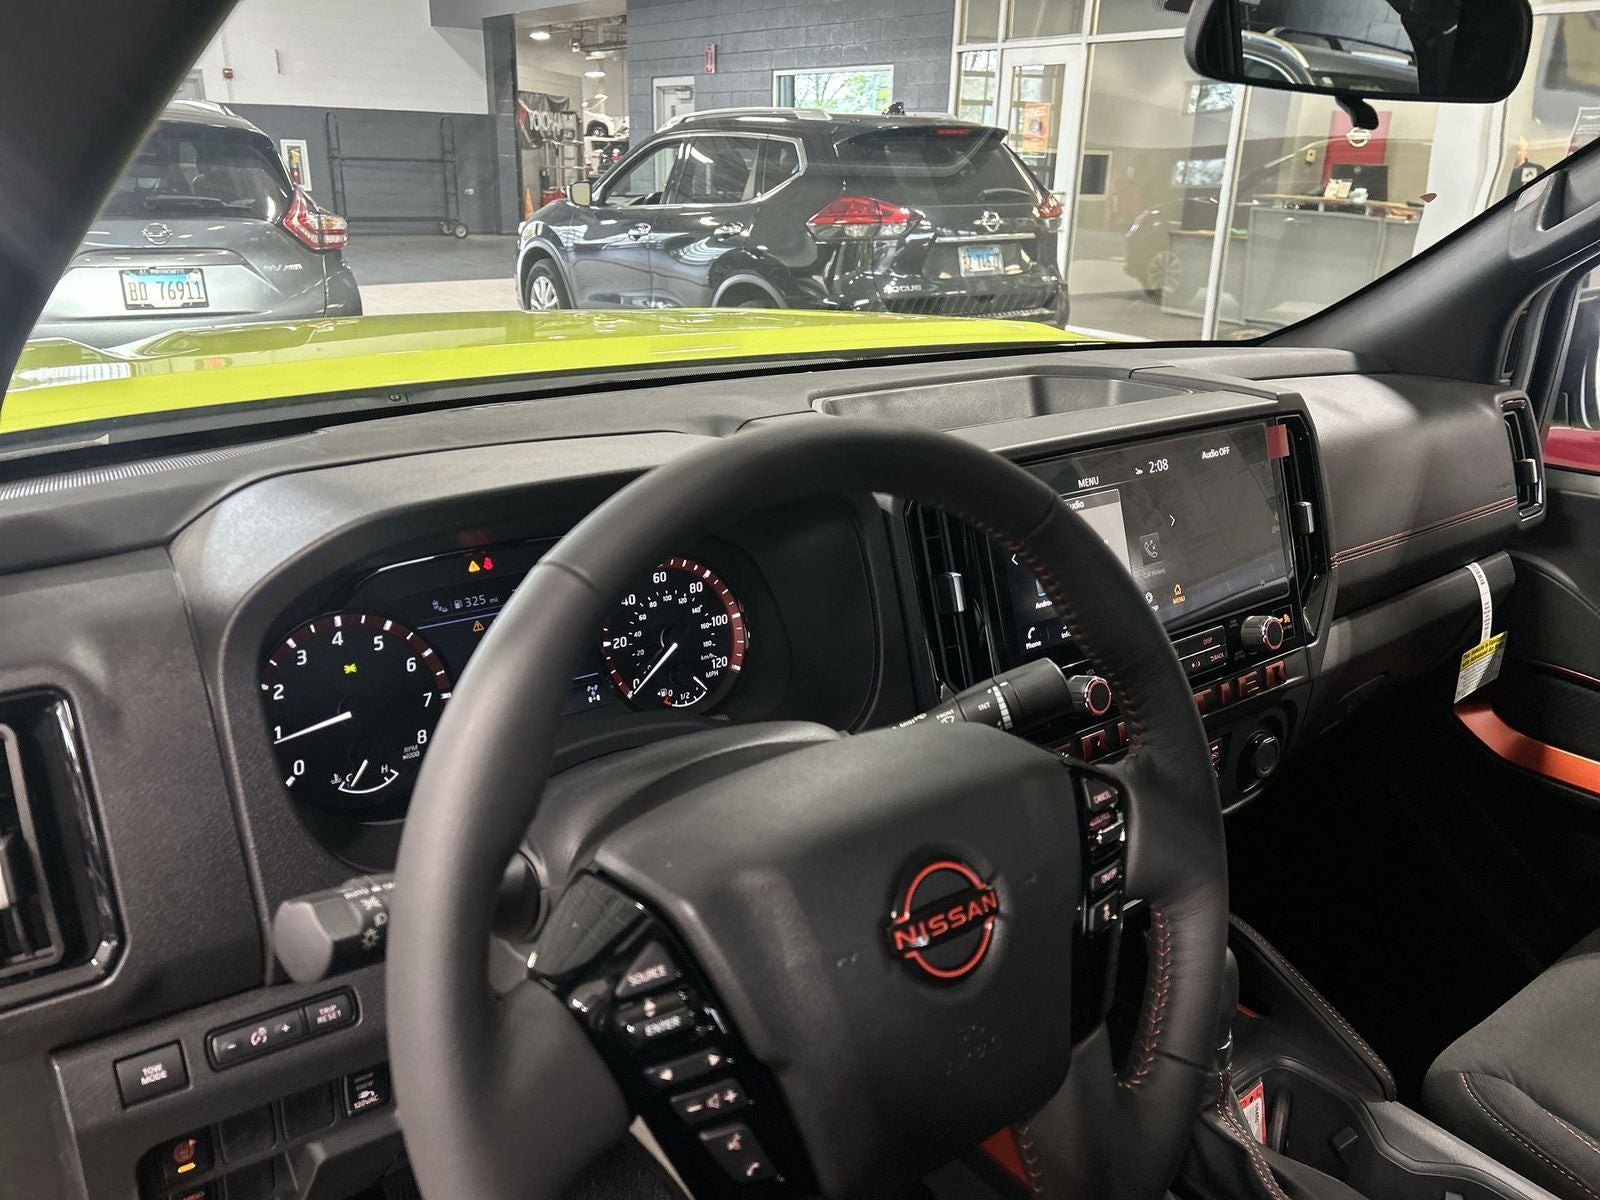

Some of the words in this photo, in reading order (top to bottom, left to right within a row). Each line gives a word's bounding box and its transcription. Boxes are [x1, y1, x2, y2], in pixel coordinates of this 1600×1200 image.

[128, 282, 148, 301] BD
[156, 280, 204, 300] 76911
[1202, 449, 1218, 459] Audio
[1219, 446, 1230, 456] OFF
[1148, 458, 1169, 473] 2:08
[1078, 476, 1099, 489] MENU
[652, 571, 667, 583] 60
[689, 581, 703, 593] 80
[465, 595, 487, 608] 325
[621, 594, 636, 606] 40
[662, 594, 673, 602] 100
[711, 614, 728, 627] 100
[331, 631, 343, 646] 4
[373, 635, 384, 651] 5
[613, 636, 627, 649] 20
[1025, 639, 1042, 650] Phone
[296, 650, 307, 665] 3
[712, 656, 728, 669] 120
[406, 657, 416, 672] 6
[705, 671, 718, 679] MPH
[273, 684, 284, 700] 2
[423, 692, 432, 707] 7
[978, 701, 991, 713] INT
[274, 726, 282, 739] 1
[417, 730, 427, 744] 8
[293, 759, 305, 775] 0
[381, 765, 388, 773] H
[893, 891, 998, 951] NISSAN
[140, 1071, 168, 1086] MODE
